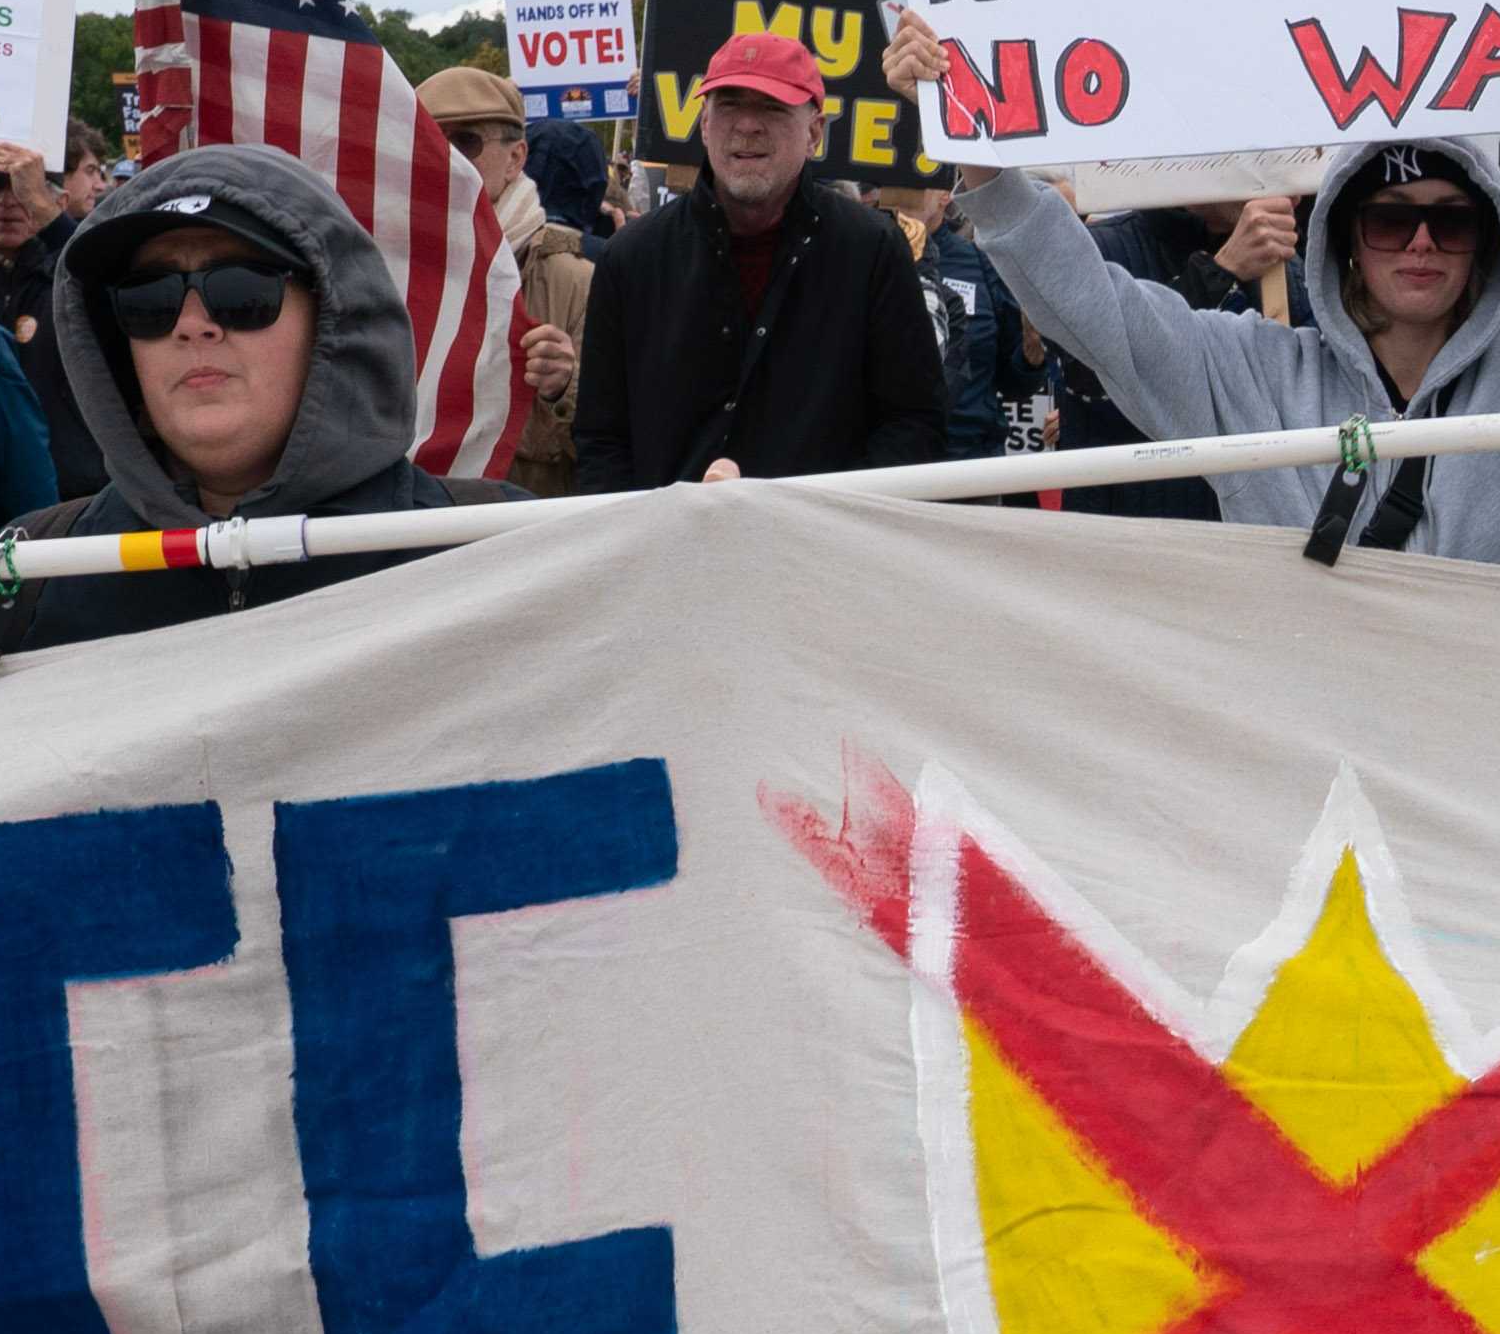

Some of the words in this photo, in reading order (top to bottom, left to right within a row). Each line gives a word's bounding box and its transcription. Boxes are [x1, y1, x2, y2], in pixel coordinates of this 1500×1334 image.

[517, 5, 564, 22] HANDS
[569, 3, 594, 18] OFF
[600, 1, 619, 17] MY
[518, 27, 624, 68] VOTE!
[937, 37, 1129, 141] NO
